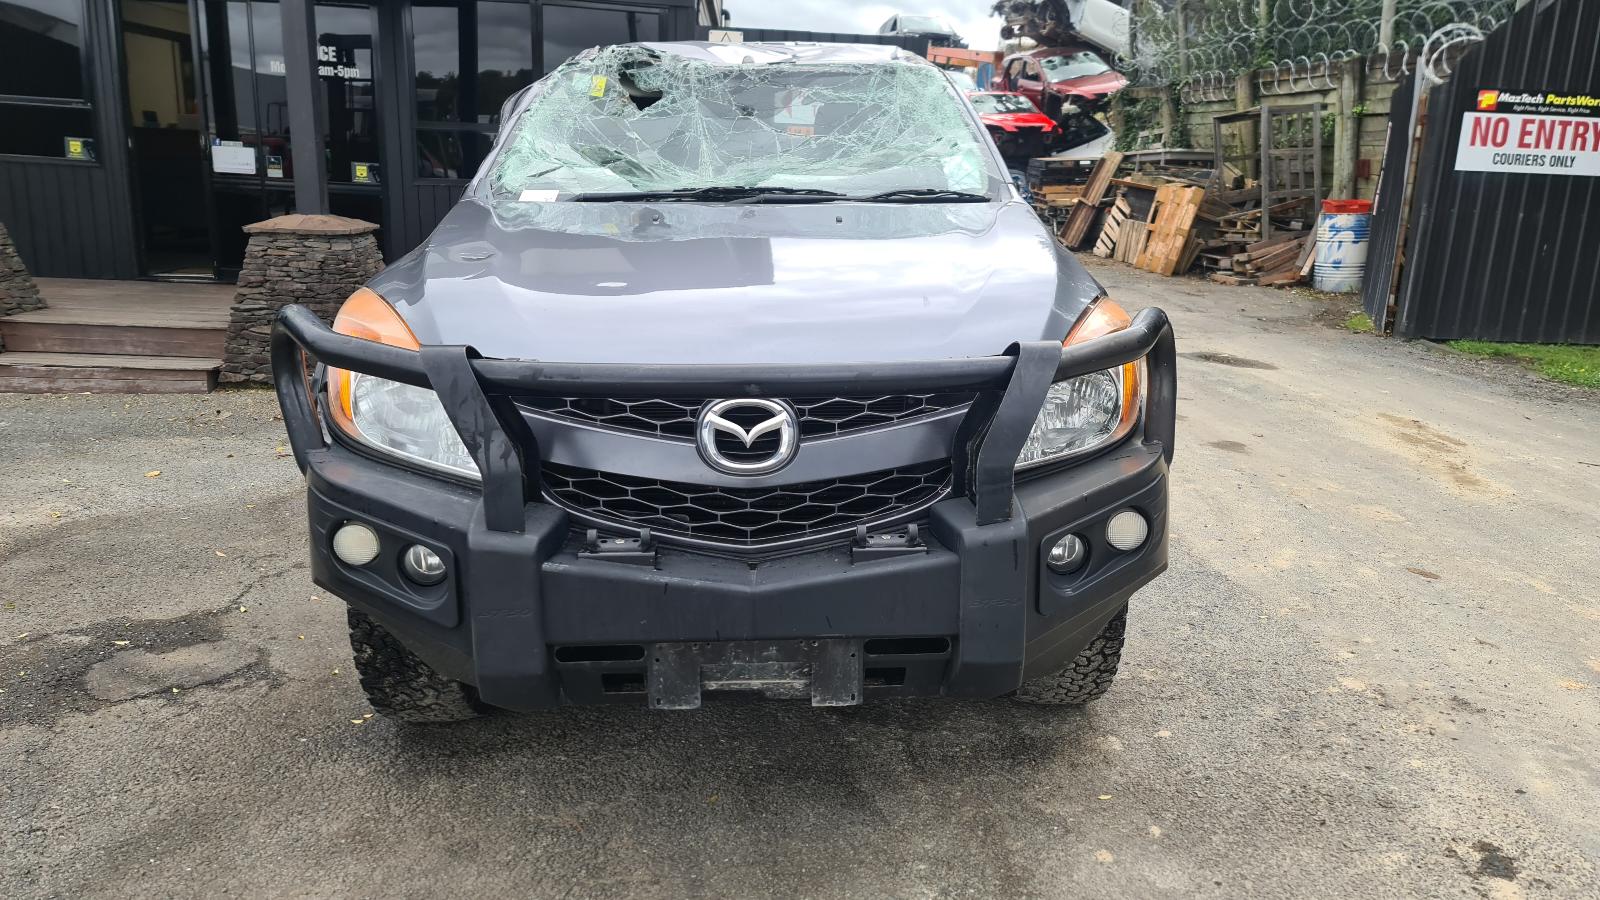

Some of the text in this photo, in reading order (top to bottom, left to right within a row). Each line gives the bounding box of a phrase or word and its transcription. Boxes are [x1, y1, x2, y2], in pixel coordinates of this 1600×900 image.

[318, 65, 360, 79] am-5pm
[1498, 92, 1544, 104] MazTech
[1469, 116, 1600, 152] NO ENTRY
[1492, 153, 1576, 168] COURIERS ONLY
